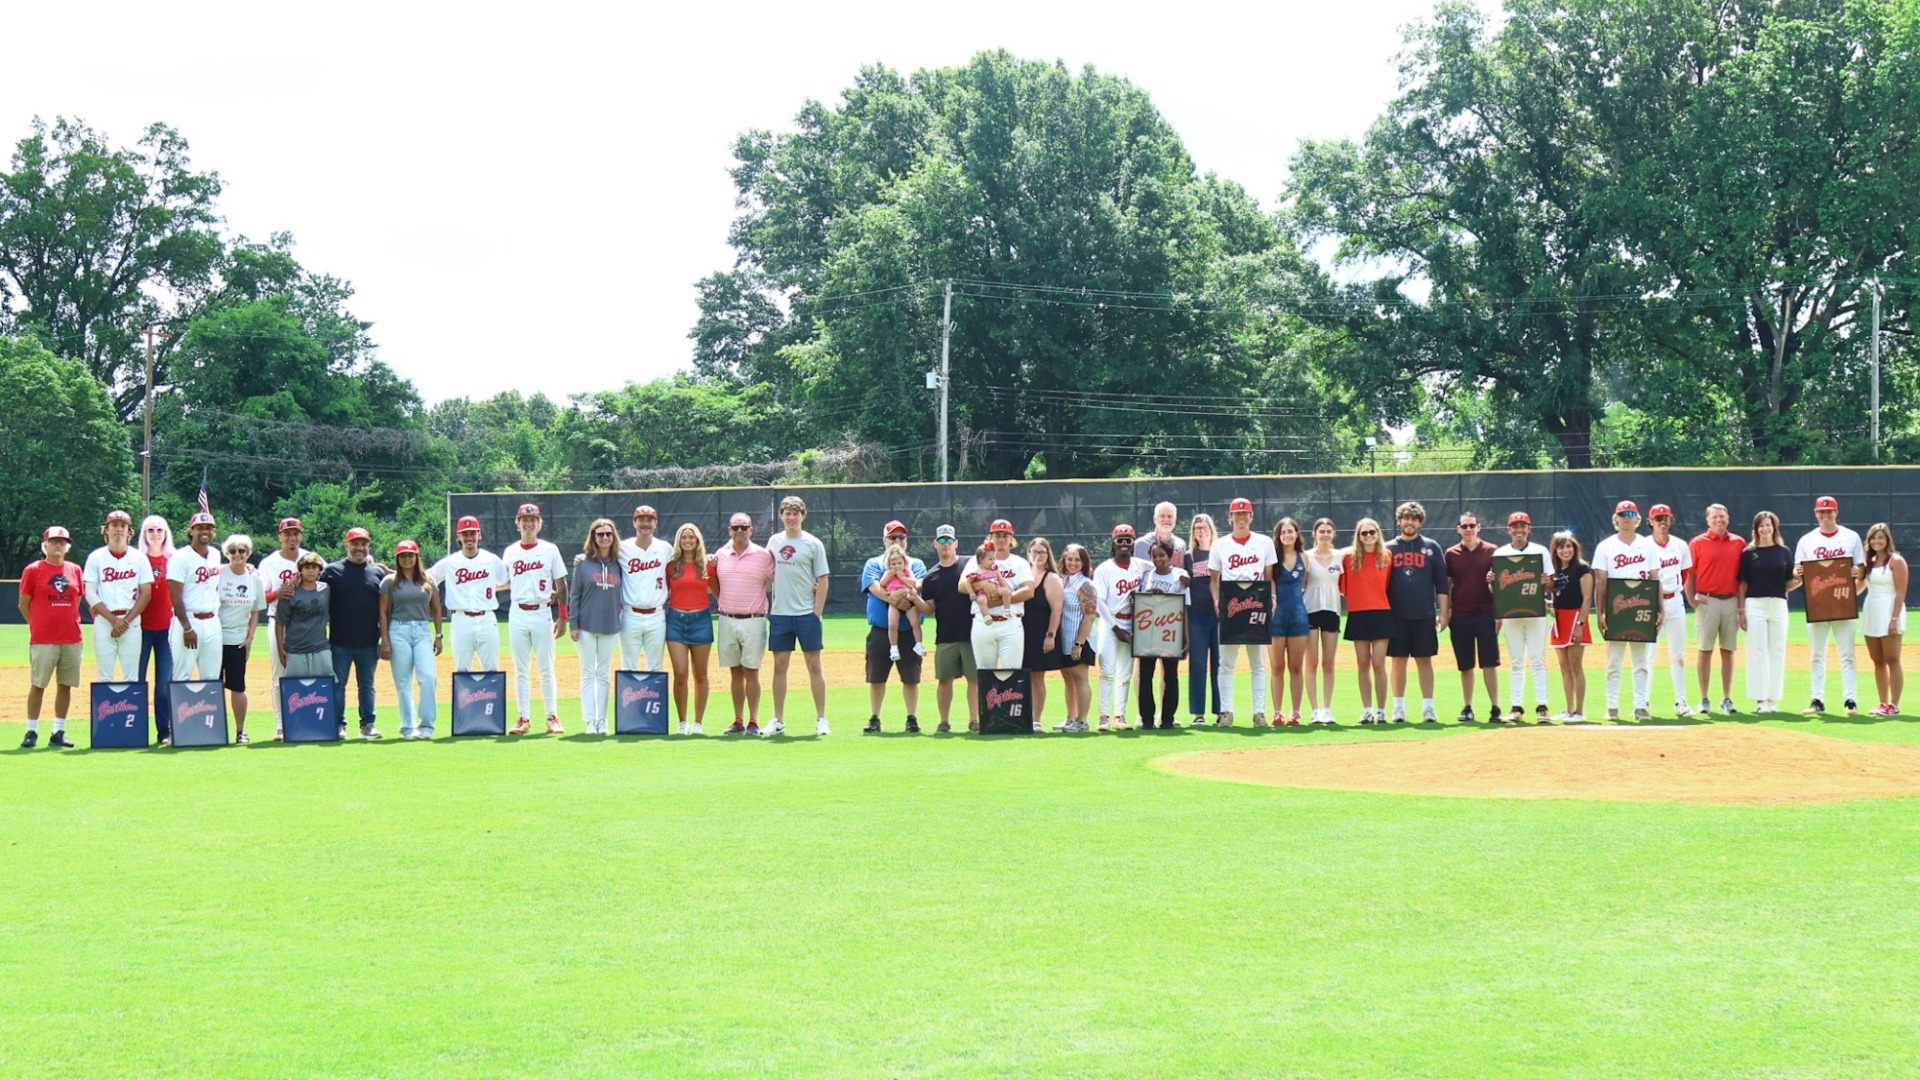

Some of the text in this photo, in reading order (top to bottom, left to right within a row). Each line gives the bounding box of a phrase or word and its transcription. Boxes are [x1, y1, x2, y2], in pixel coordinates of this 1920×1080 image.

[1814, 547, 1846, 558] Bucs
[628, 558, 661, 574] Bucs
[1228, 554, 1260, 570] Bucs
[1393, 552, 1425, 568] CBU
[1614, 554, 1646, 569] Bucs
[1660, 556, 1679, 568] ucs
[513, 560, 544, 576] Bucs
[102, 567, 137, 583] Bucs
[455, 568, 489, 585] Bucs
[538, 579, 546, 591] 5
[1521, 583, 1538, 595] 28
[485, 587, 492, 599] 8
[1833, 587, 1850, 599] 44
[1135, 609, 1184, 631] Bucs
[1249, 612, 1267, 625] 24
[1635, 609, 1652, 622] 35
[1162, 630, 1176, 642] 21
[315, 707, 325, 720] 7
[485, 702, 494, 715] 8
[645, 701, 661, 714] 15
[1009, 704, 1023, 716] 16
[125, 714, 135, 727] 2
[205, 715, 214, 728] 4
